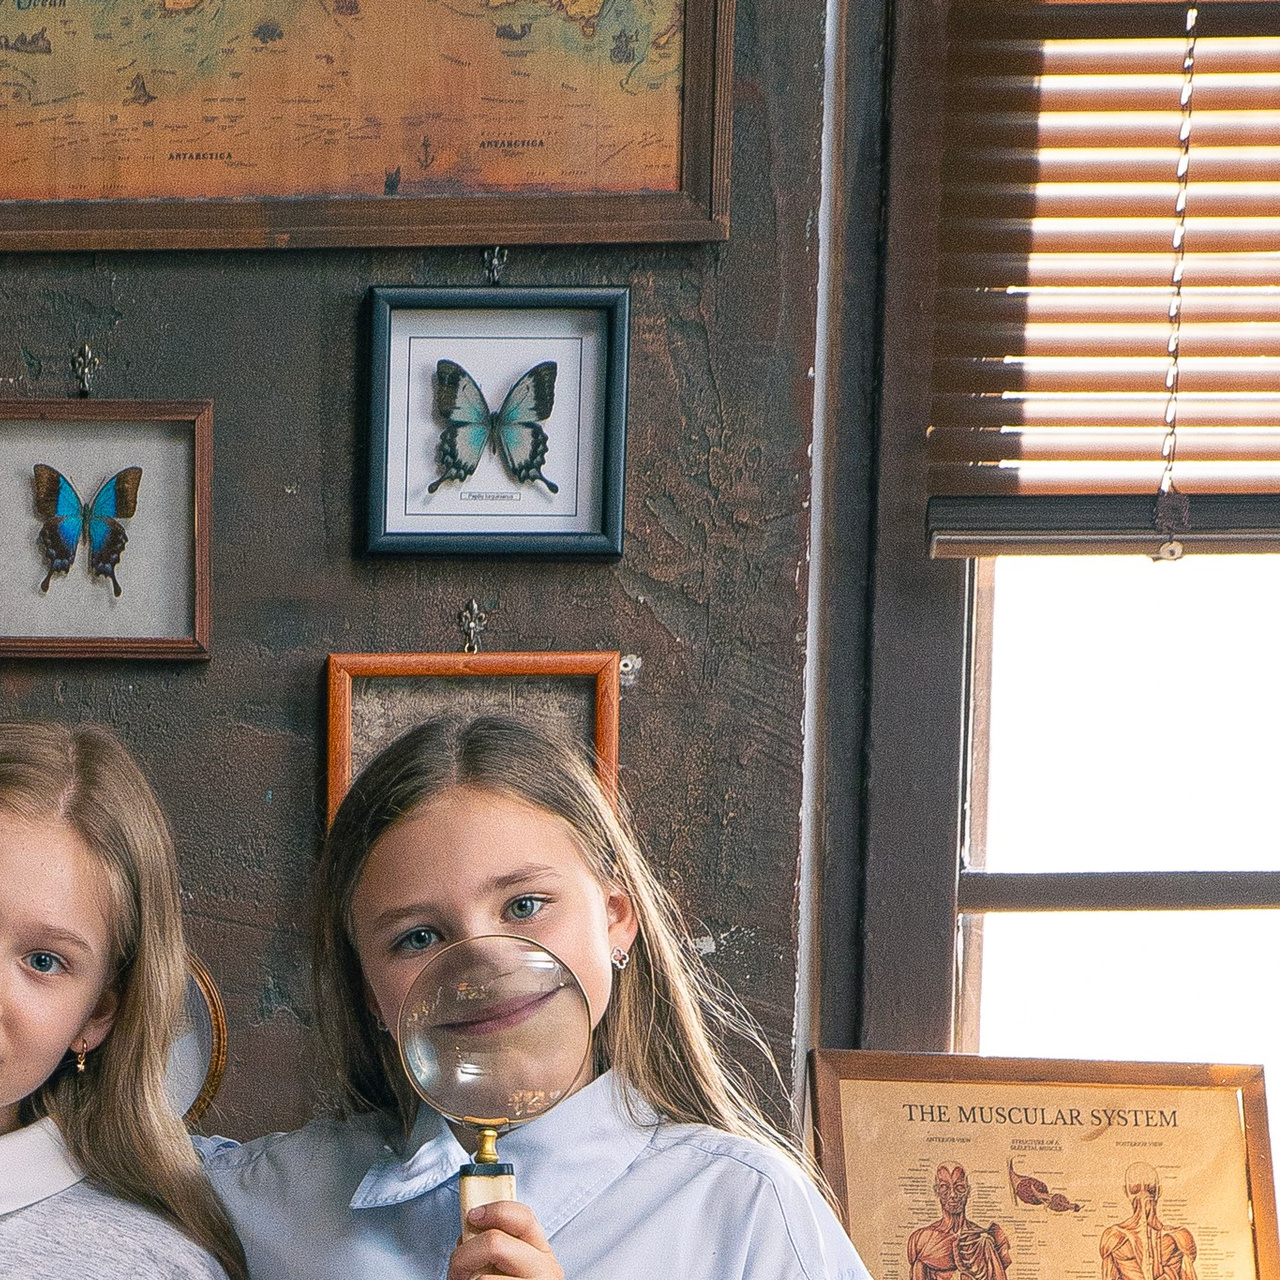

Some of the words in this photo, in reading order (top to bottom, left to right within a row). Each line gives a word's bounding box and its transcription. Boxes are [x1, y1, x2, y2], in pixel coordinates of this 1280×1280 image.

[902, 1103, 951, 1123] THE
[958, 1105, 1082, 1127] MUSCULAR
[1090, 1109, 1179, 1128] SYSTEM
